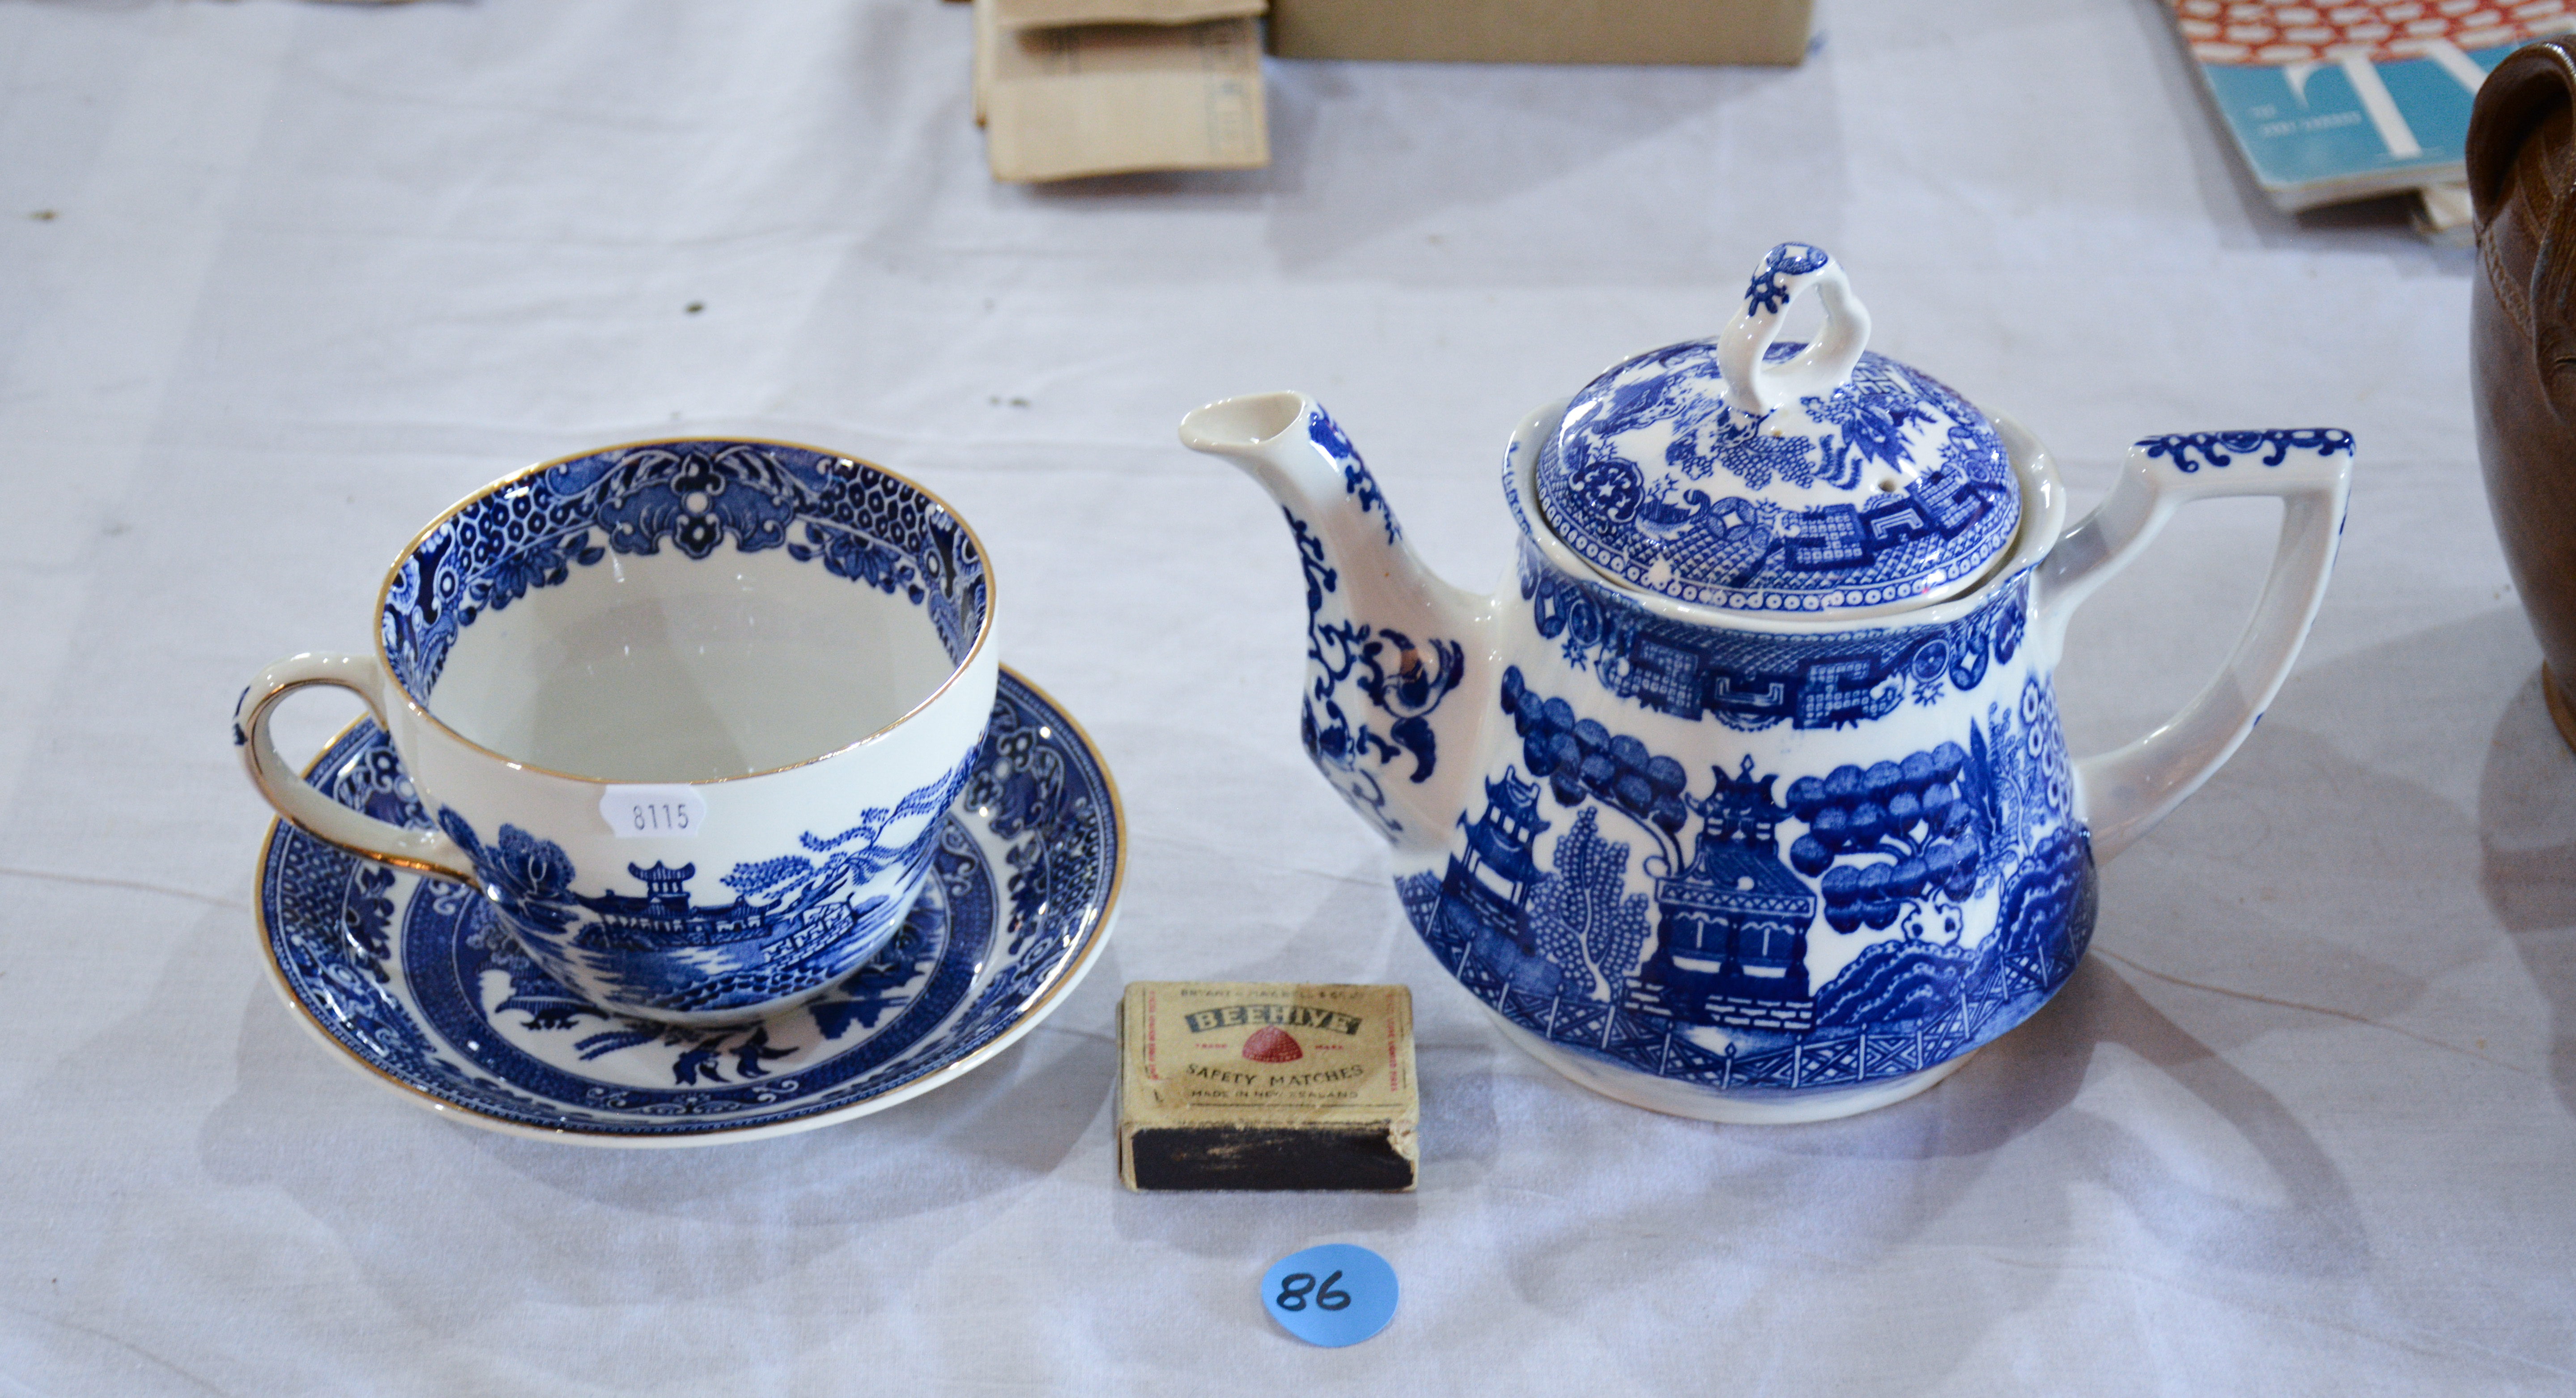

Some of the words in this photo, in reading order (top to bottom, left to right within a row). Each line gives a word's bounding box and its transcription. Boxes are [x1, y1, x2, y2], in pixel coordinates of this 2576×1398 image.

[632, 803, 689, 831] 8115
[1194, 1007, 1354, 1032] BEEHIVE
[1186, 1062, 1258, 1085] SAFETY
[1269, 1064, 1364, 1087] MATCHES
[1191, 1090, 1228, 1098] MADE
[1235, 1090, 1249, 1098] IN
[1254, 1090, 1283, 1098] NEW
[1289, 1090, 1359, 1099] ZEALAND
[1276, 1269, 1352, 1312] 86
